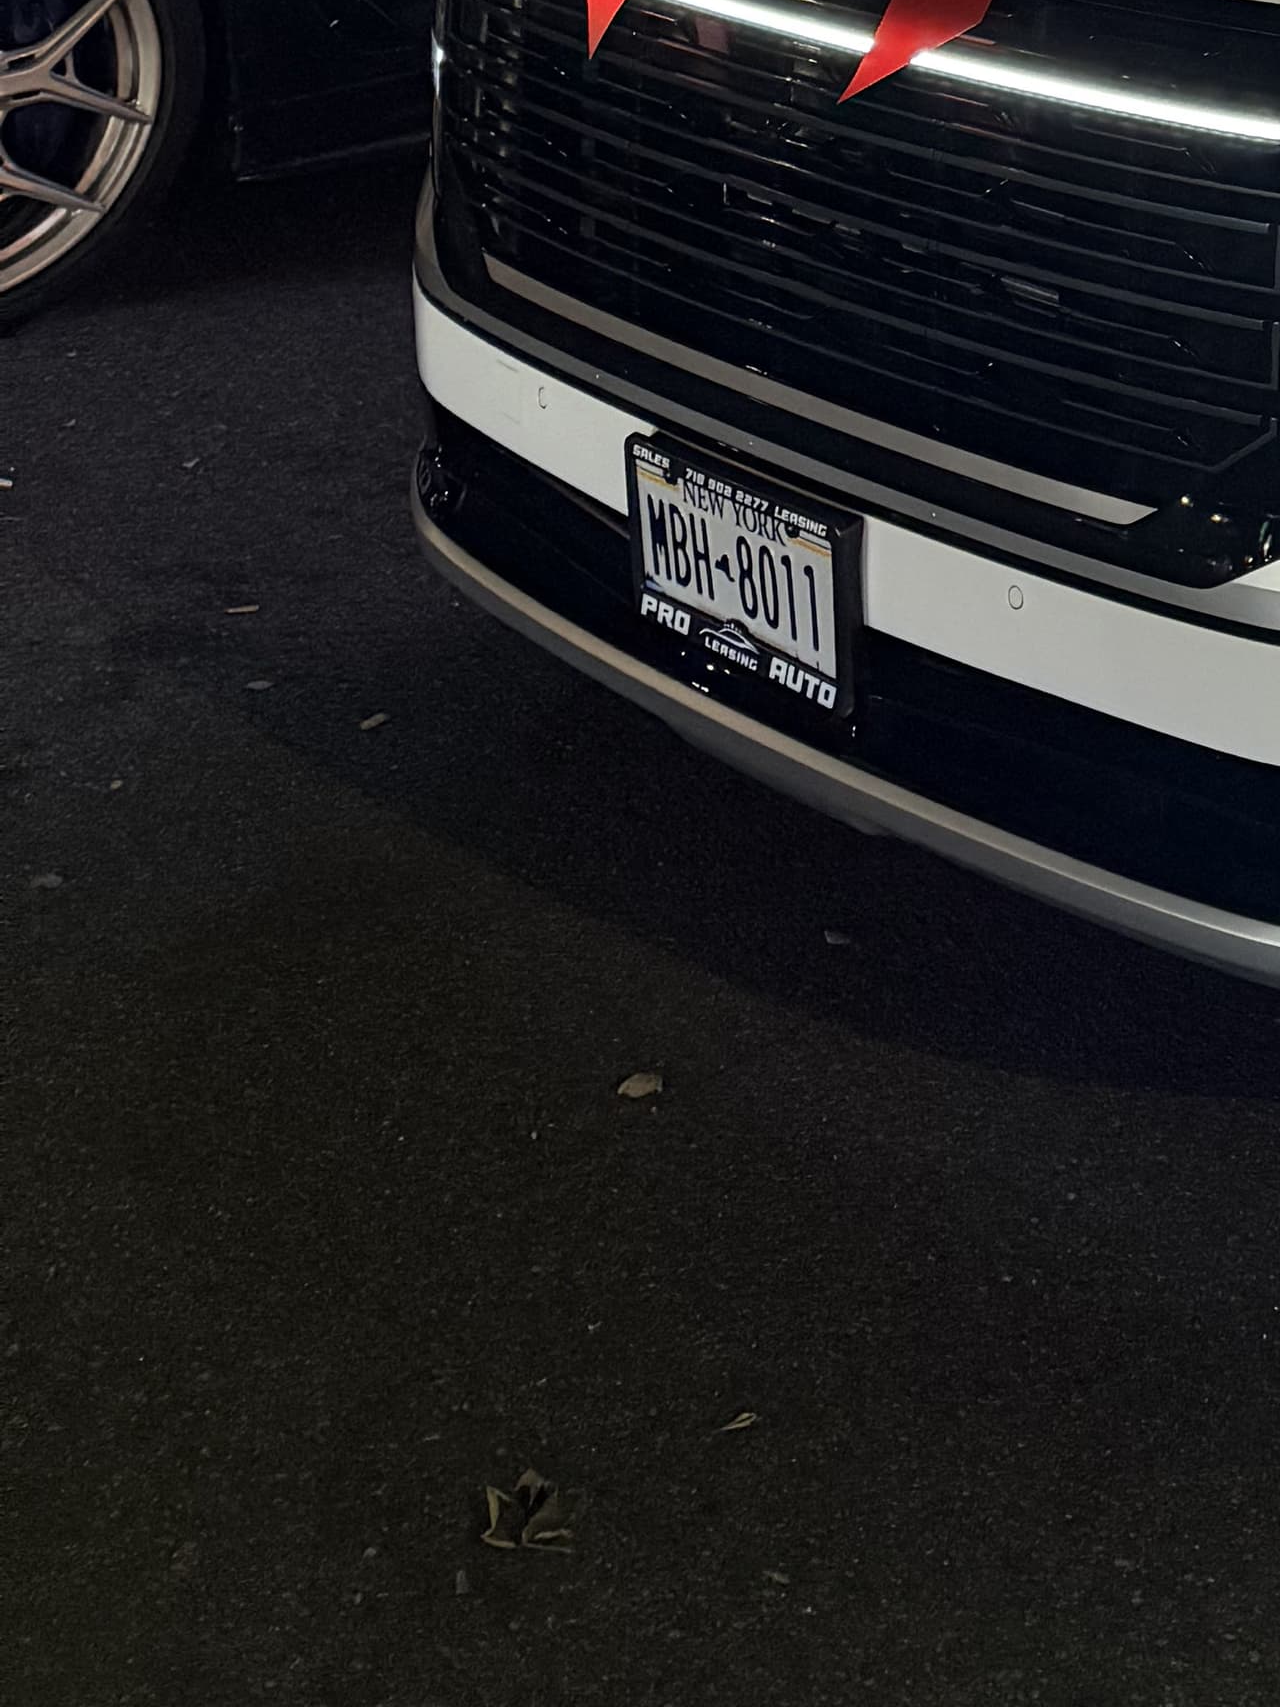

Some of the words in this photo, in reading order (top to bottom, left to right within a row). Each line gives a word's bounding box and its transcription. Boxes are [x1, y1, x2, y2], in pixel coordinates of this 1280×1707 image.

[633, 444, 670, 468] SALES
[682, 478, 724, 519] NEW
[732, 499, 787, 546] YORK
[685, 468, 704, 486] 718
[708, 479, 732, 498] 902
[735, 490, 769, 512] 2277
[774, 506, 828, 537] LEASING
[647, 493, 716, 601] MBH
[736, 536, 819, 652] 8011
[641, 593, 691, 635] PRO
[769, 657, 837, 709] AUTO
[704, 636, 758, 672] LEASING
